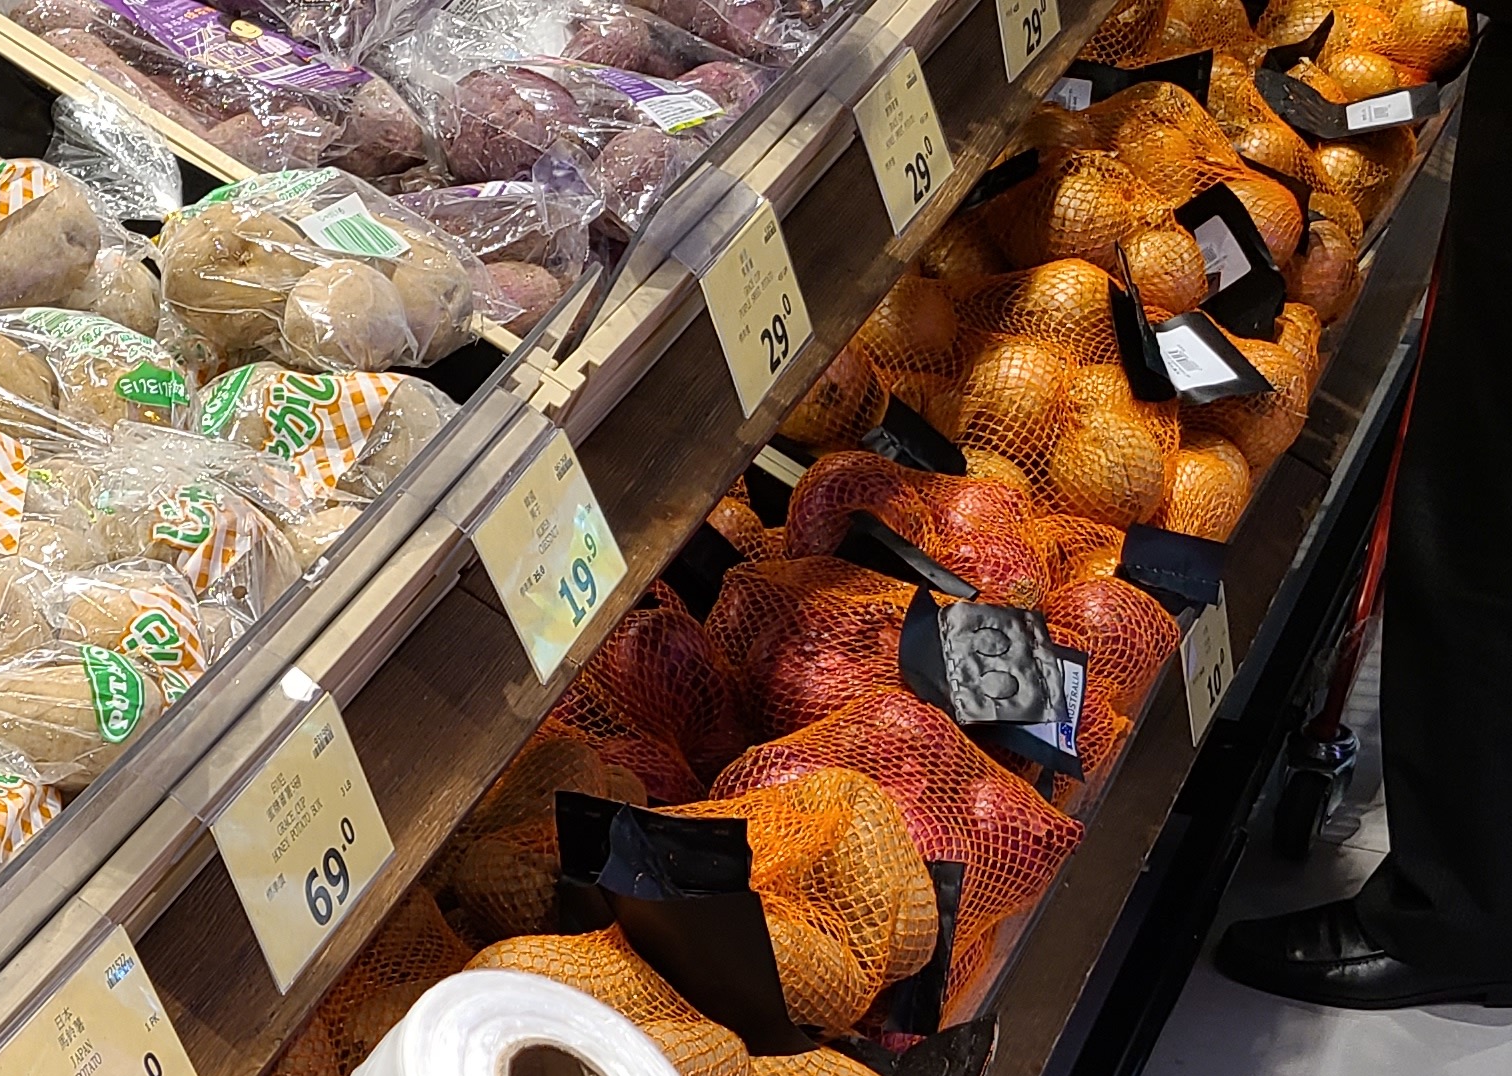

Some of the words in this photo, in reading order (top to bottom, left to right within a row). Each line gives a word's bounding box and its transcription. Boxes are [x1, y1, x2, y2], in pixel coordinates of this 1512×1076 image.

[905, 135, 933, 205] 29.0
[760, 293, 791, 375] 29.0
[558, 532, 598, 628] 19.9
[291, 813, 312, 842] POTATO
[305, 816, 356, 926] 69.0
[54, 1006, 74, 1031] 日本
[70, 1038, 94, 1069] JAPAN
